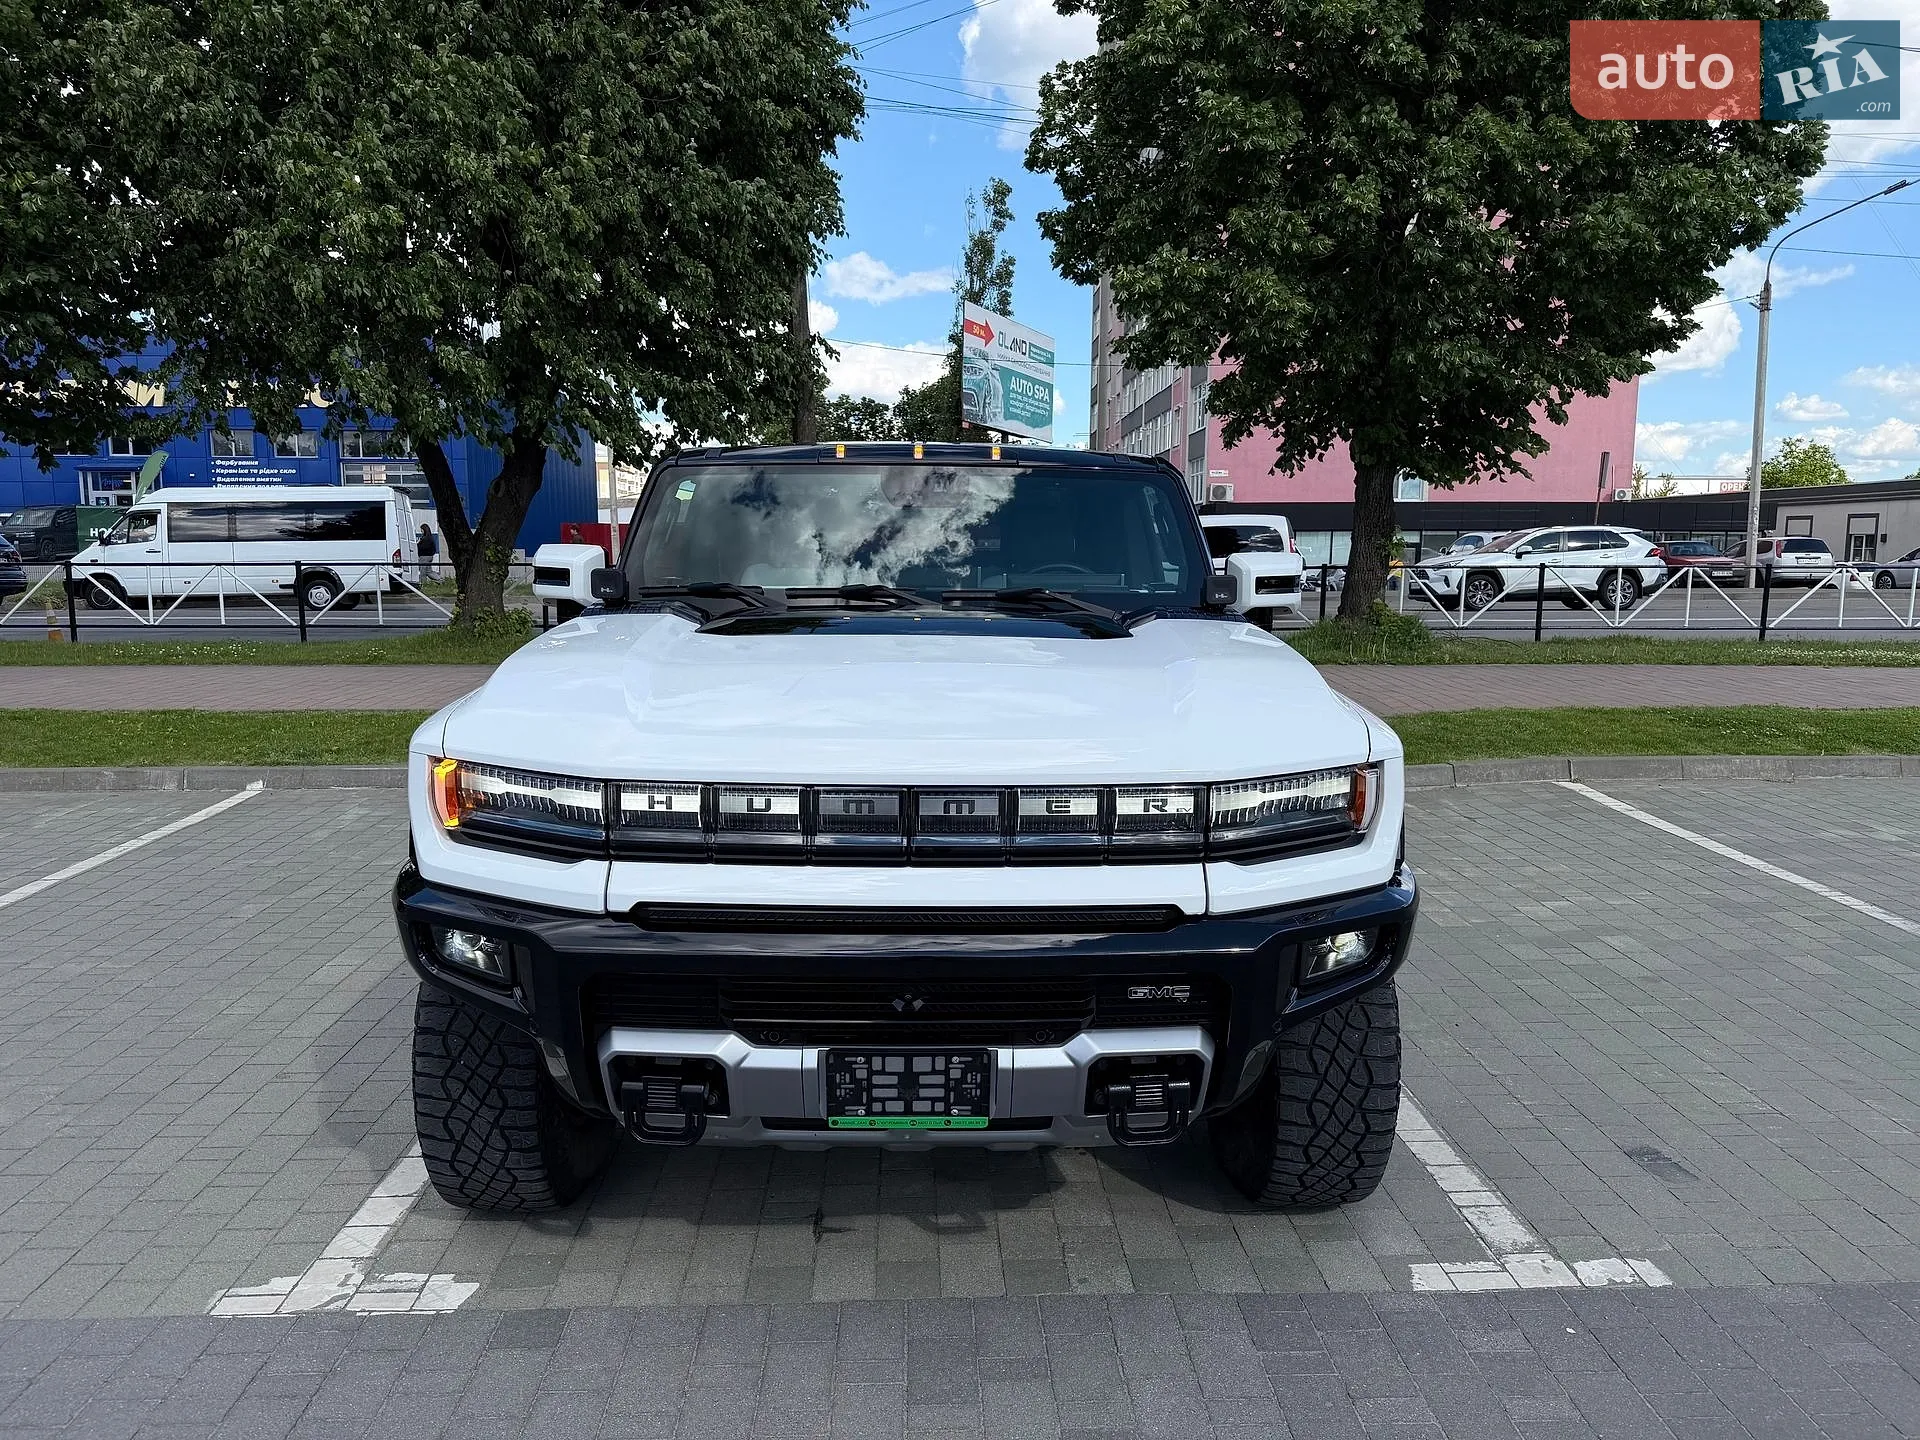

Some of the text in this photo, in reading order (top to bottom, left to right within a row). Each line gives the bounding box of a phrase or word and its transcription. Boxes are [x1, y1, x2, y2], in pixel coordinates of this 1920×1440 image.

[1010, 376, 1034, 397] AUTO
[1034, 384, 1050, 403] SPA
[215, 459, 259, 467] Фарбування
[215, 467, 248, 475] Кераміка
[259, 467, 278, 475] рідке
[648, 794, 1168, 815] HUMMER
[1128, 986, 1191, 999] GMC
